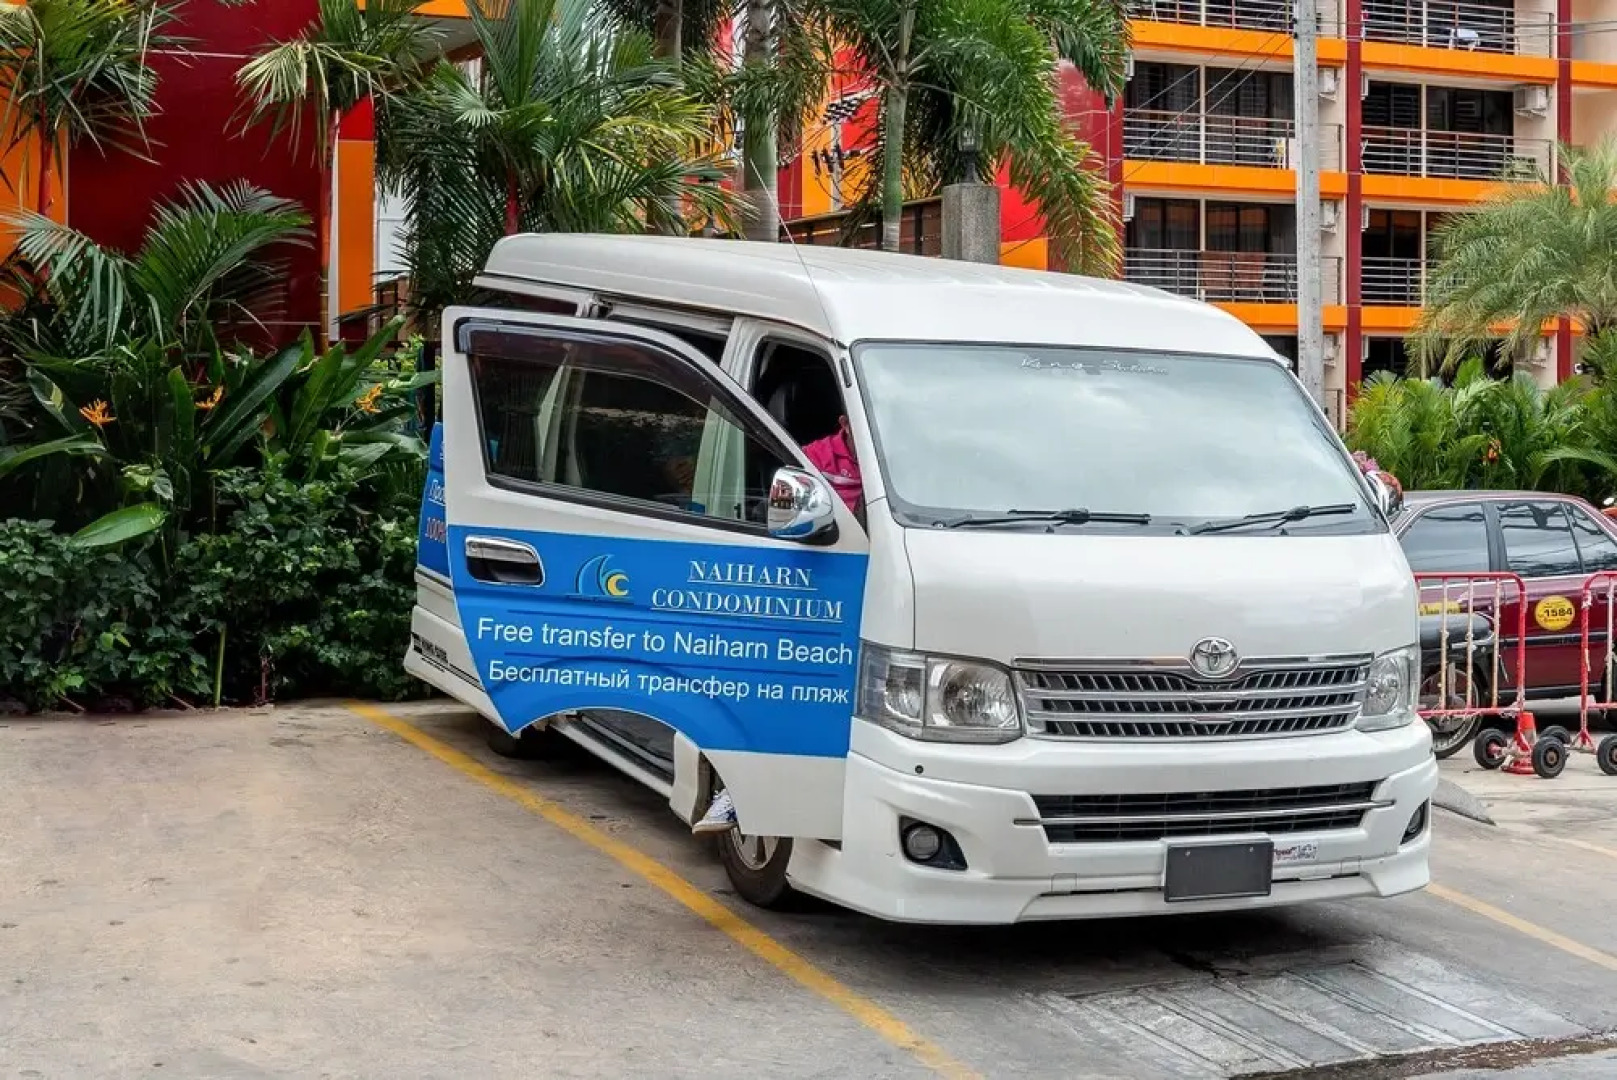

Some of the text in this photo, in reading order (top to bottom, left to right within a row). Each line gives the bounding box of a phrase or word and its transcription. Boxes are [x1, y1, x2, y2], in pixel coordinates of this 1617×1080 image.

[689, 560, 813, 587] NAIHARN
[652, 588, 845, 620] CONDOMINIUM
[1543, 607, 1573, 617] 1584
[477, 617, 853, 665] Free transfer to Naiharn Beach
[489, 660, 850, 705] Бесплатный трансфер на пляж
